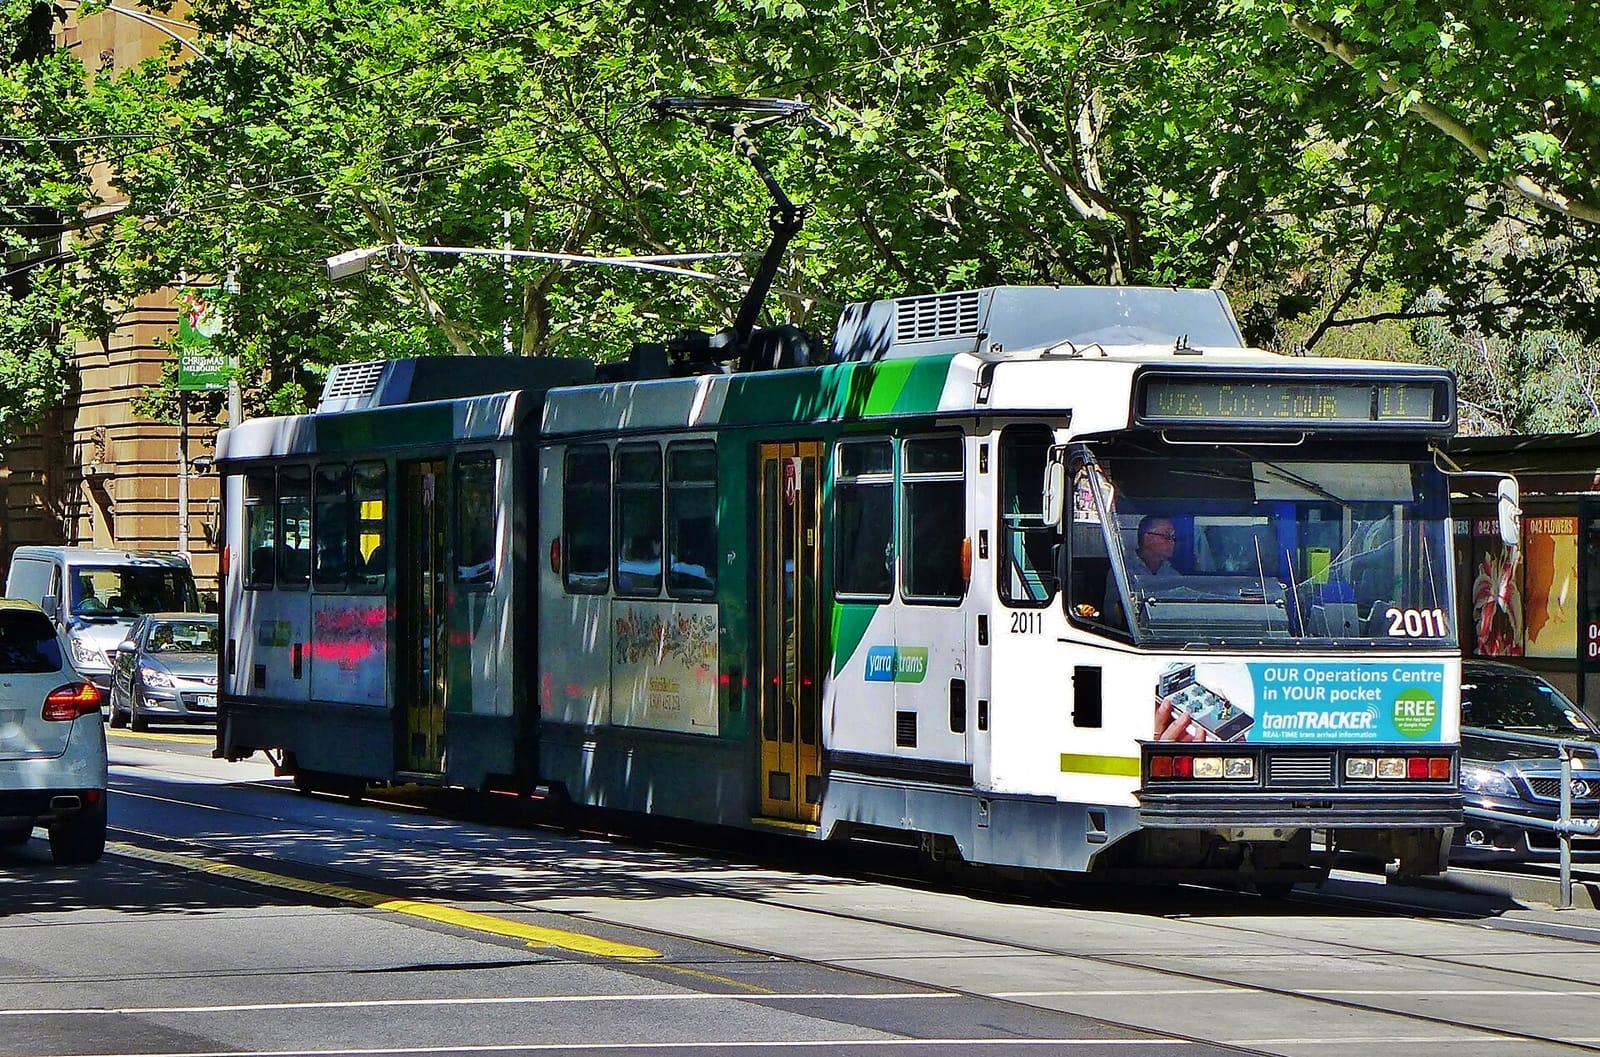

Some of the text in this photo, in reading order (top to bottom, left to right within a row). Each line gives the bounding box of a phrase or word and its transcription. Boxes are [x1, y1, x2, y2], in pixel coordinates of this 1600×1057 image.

[1382, 386, 1406, 416] 11
[1530, 519, 1573, 534] 042 FLOWERS
[1010, 611, 1042, 634] 2011
[1385, 608, 1447, 637] 2011
[1589, 624, 1600, 639] 0
[1589, 641, 1600, 657] 0
[869, 654, 923, 677] yarra trams
[1263, 667, 1442, 685] OUR Operations Centre
[1263, 685, 1382, 703] in YOUR pocket
[1394, 700, 1436, 717] FREE
[1263, 730, 1298, 738] REAL-TIME
[1316, 730, 1338, 738] arrival
[1339, 730, 1377, 738] information
